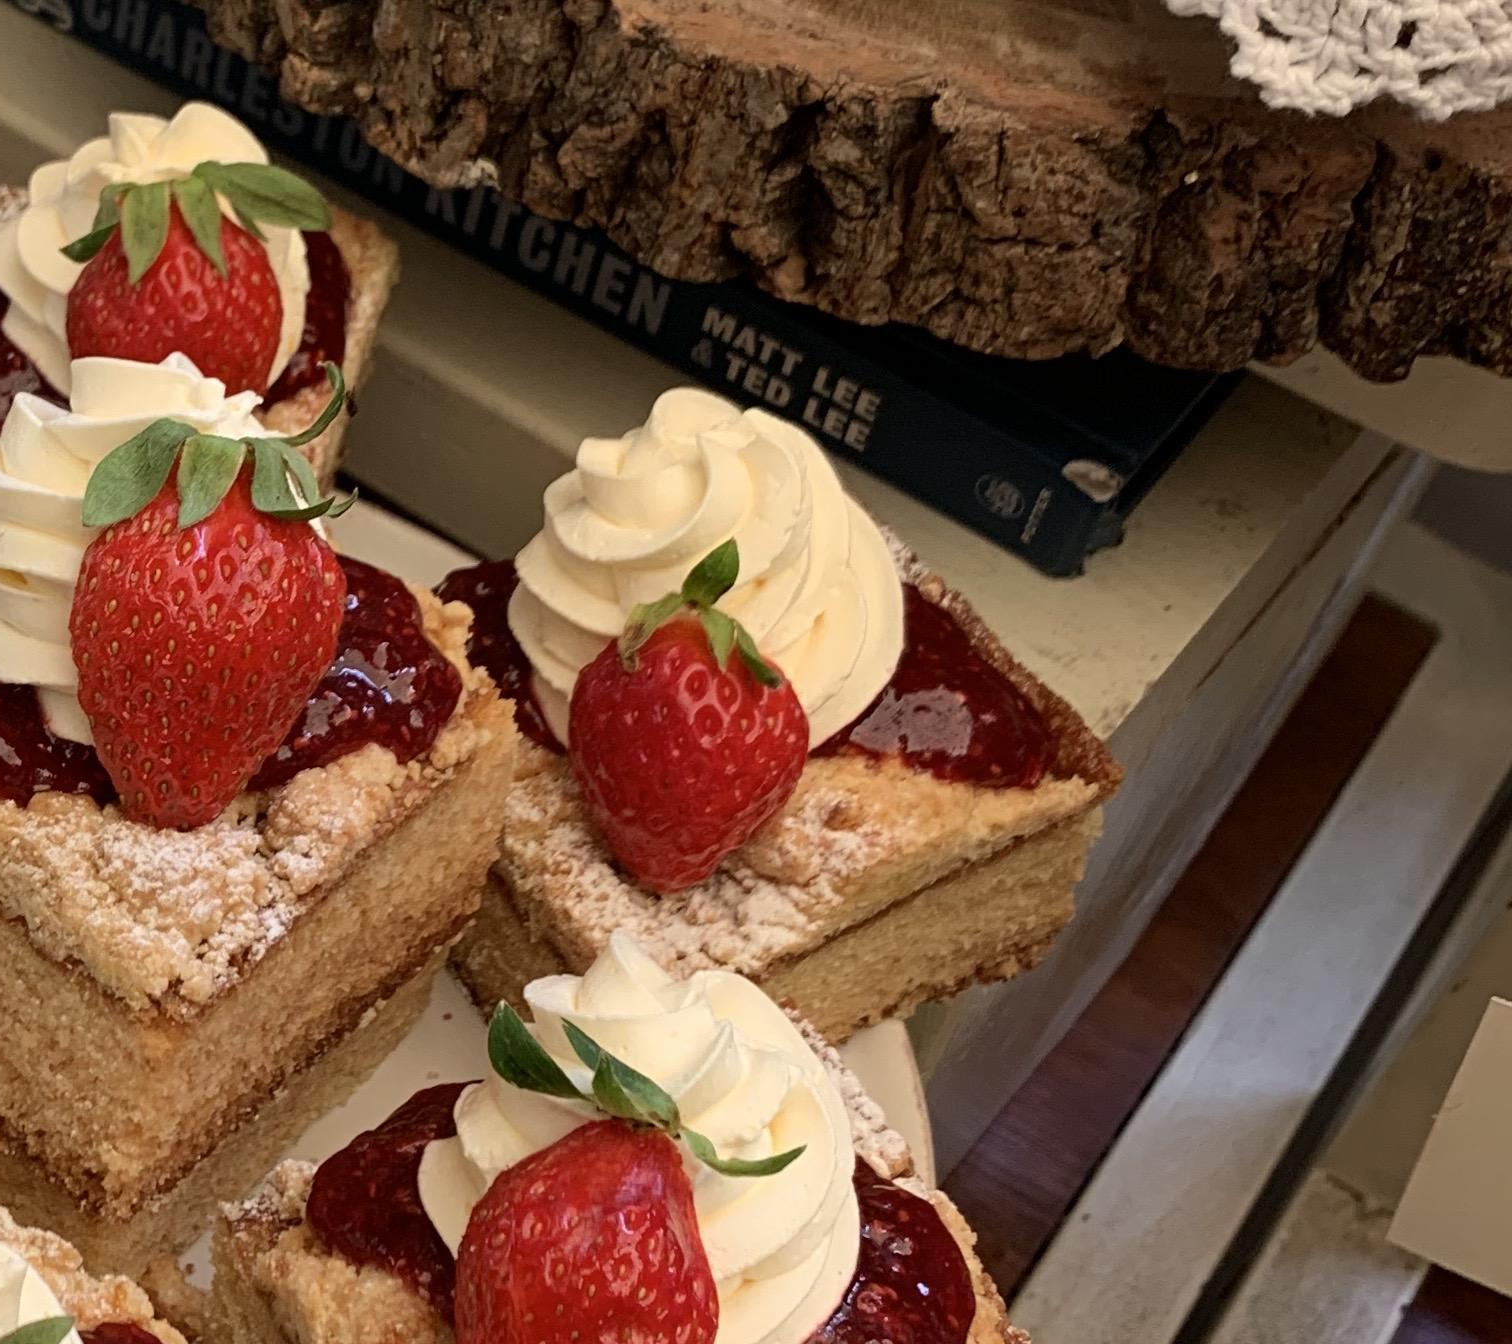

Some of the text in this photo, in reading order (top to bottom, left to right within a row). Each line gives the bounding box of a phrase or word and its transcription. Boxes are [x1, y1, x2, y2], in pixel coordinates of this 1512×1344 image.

[701, 306, 882, 422] MATT LEE
[725, 350, 793, 408] TED
[802, 395, 872, 453] LEE
